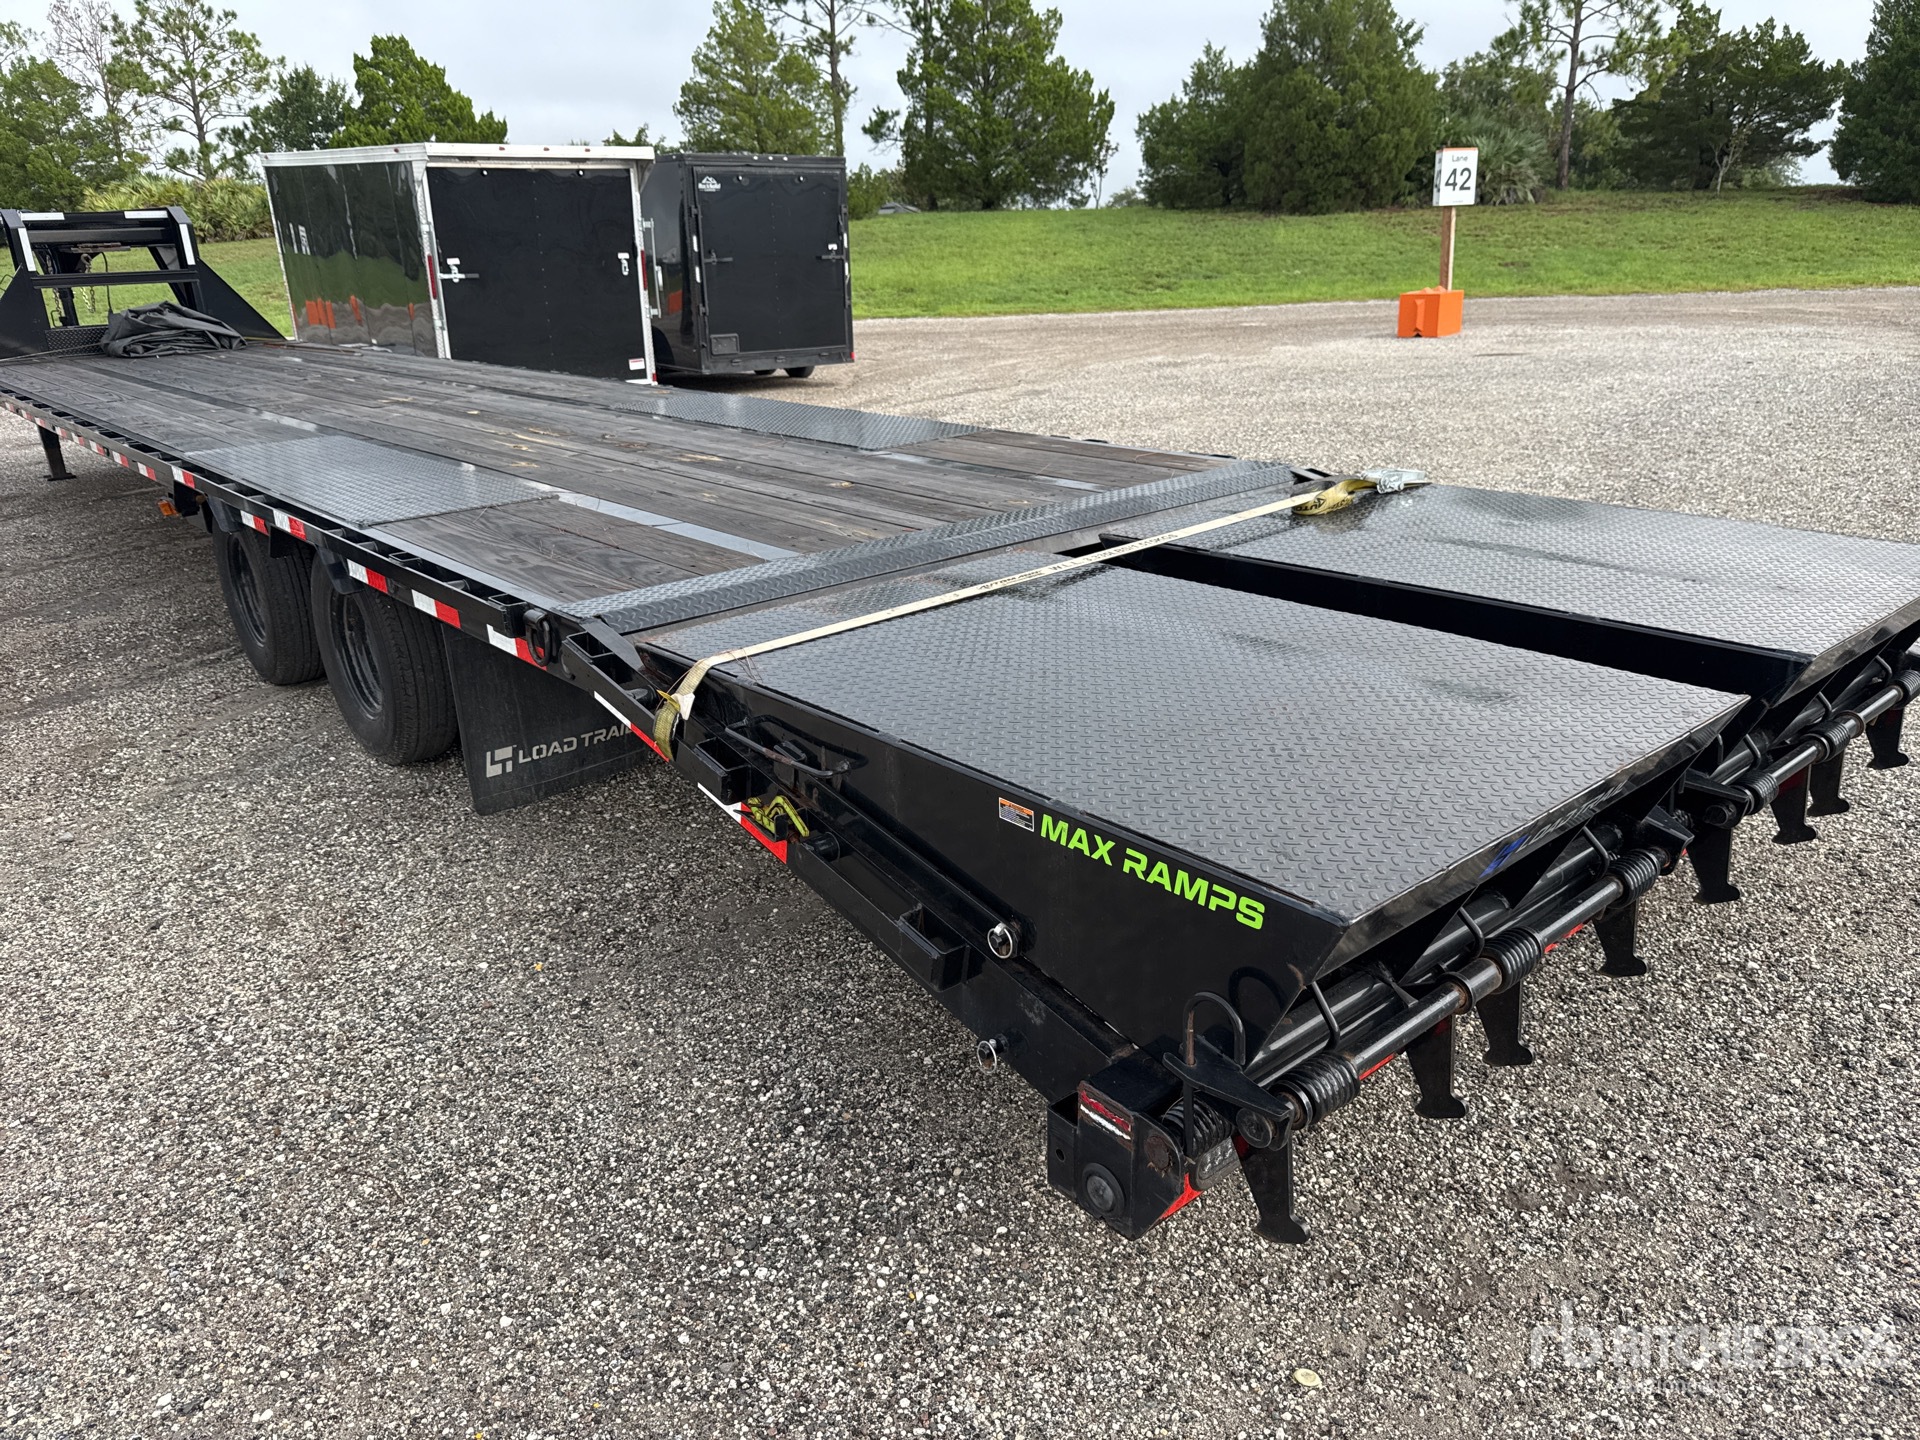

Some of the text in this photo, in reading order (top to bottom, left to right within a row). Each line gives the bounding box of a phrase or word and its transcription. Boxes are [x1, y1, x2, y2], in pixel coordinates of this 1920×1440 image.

[1445, 167, 1472, 191] 42
[519, 737, 578, 764] LOAD
[1040, 814, 1116, 866] MAX
[1122, 847, 1267, 930] RAMPS
